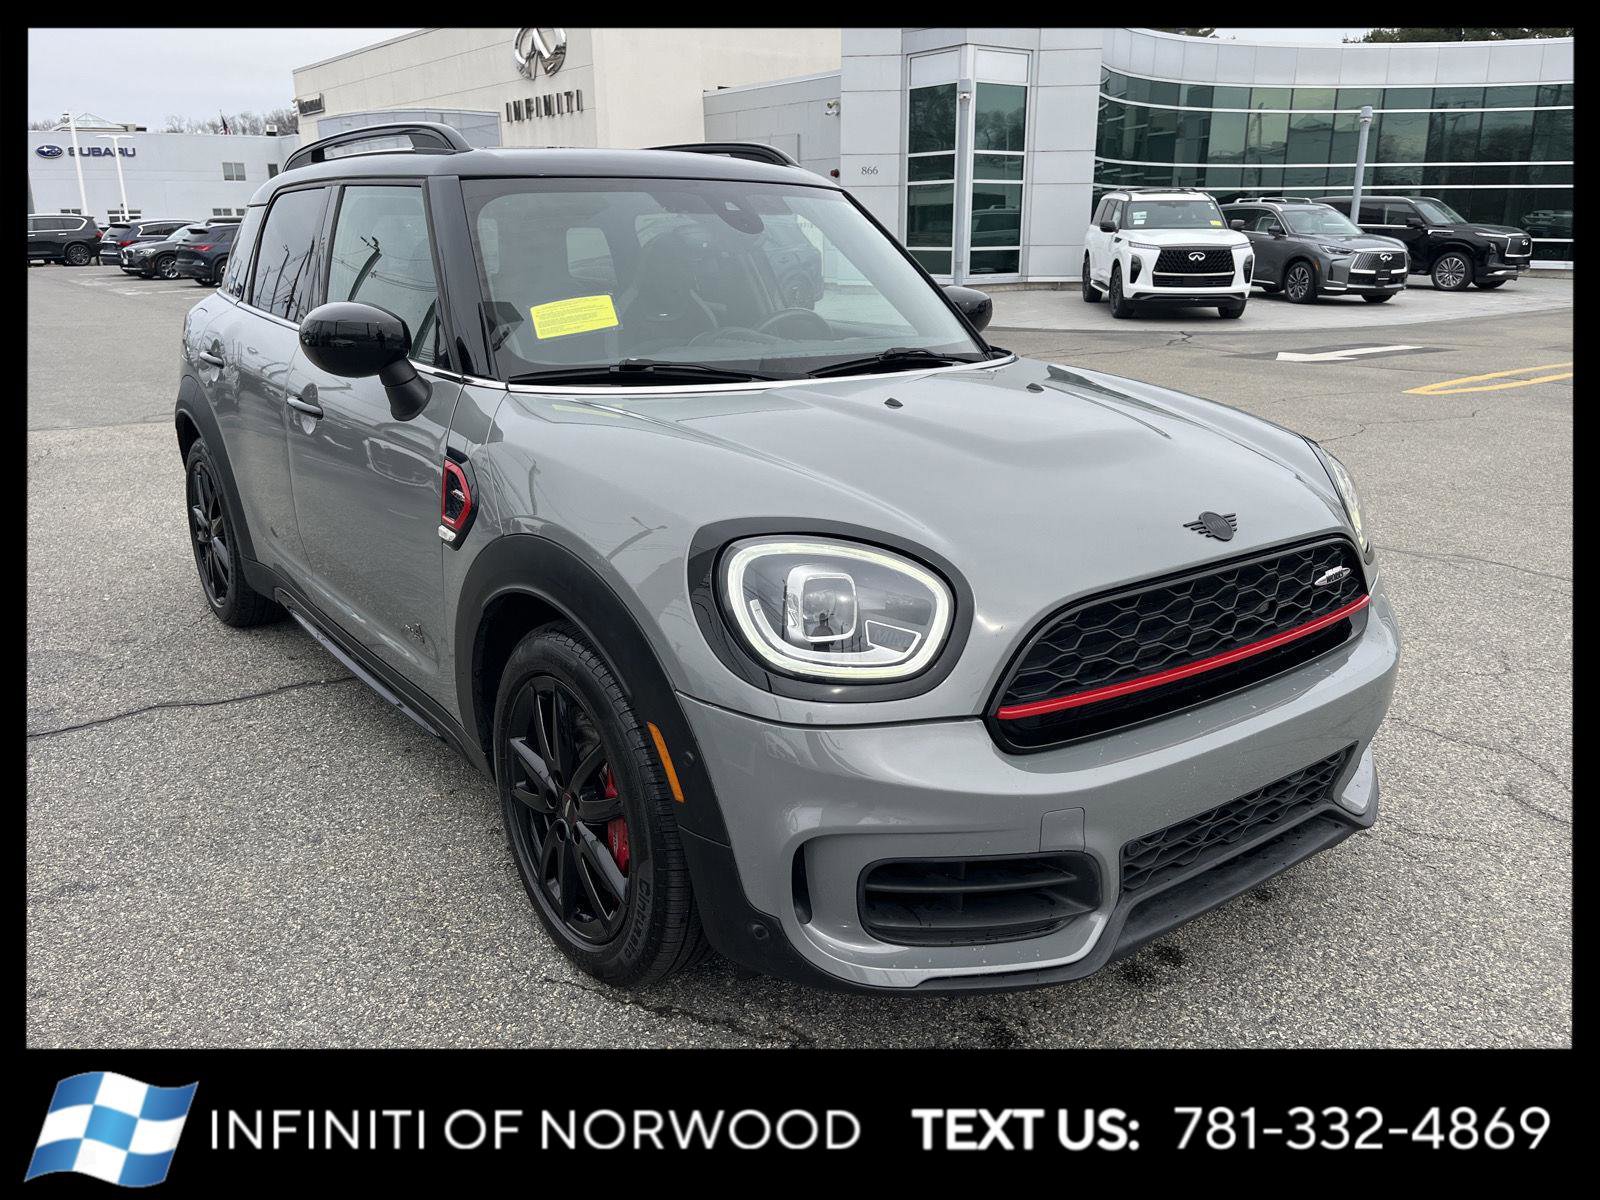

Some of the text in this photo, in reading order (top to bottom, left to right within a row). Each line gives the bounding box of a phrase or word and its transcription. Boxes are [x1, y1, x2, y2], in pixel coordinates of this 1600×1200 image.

[505, 89, 583, 124] INFINITI
[68, 147, 136, 157] SUBARU
[861, 166, 879, 175] 866
